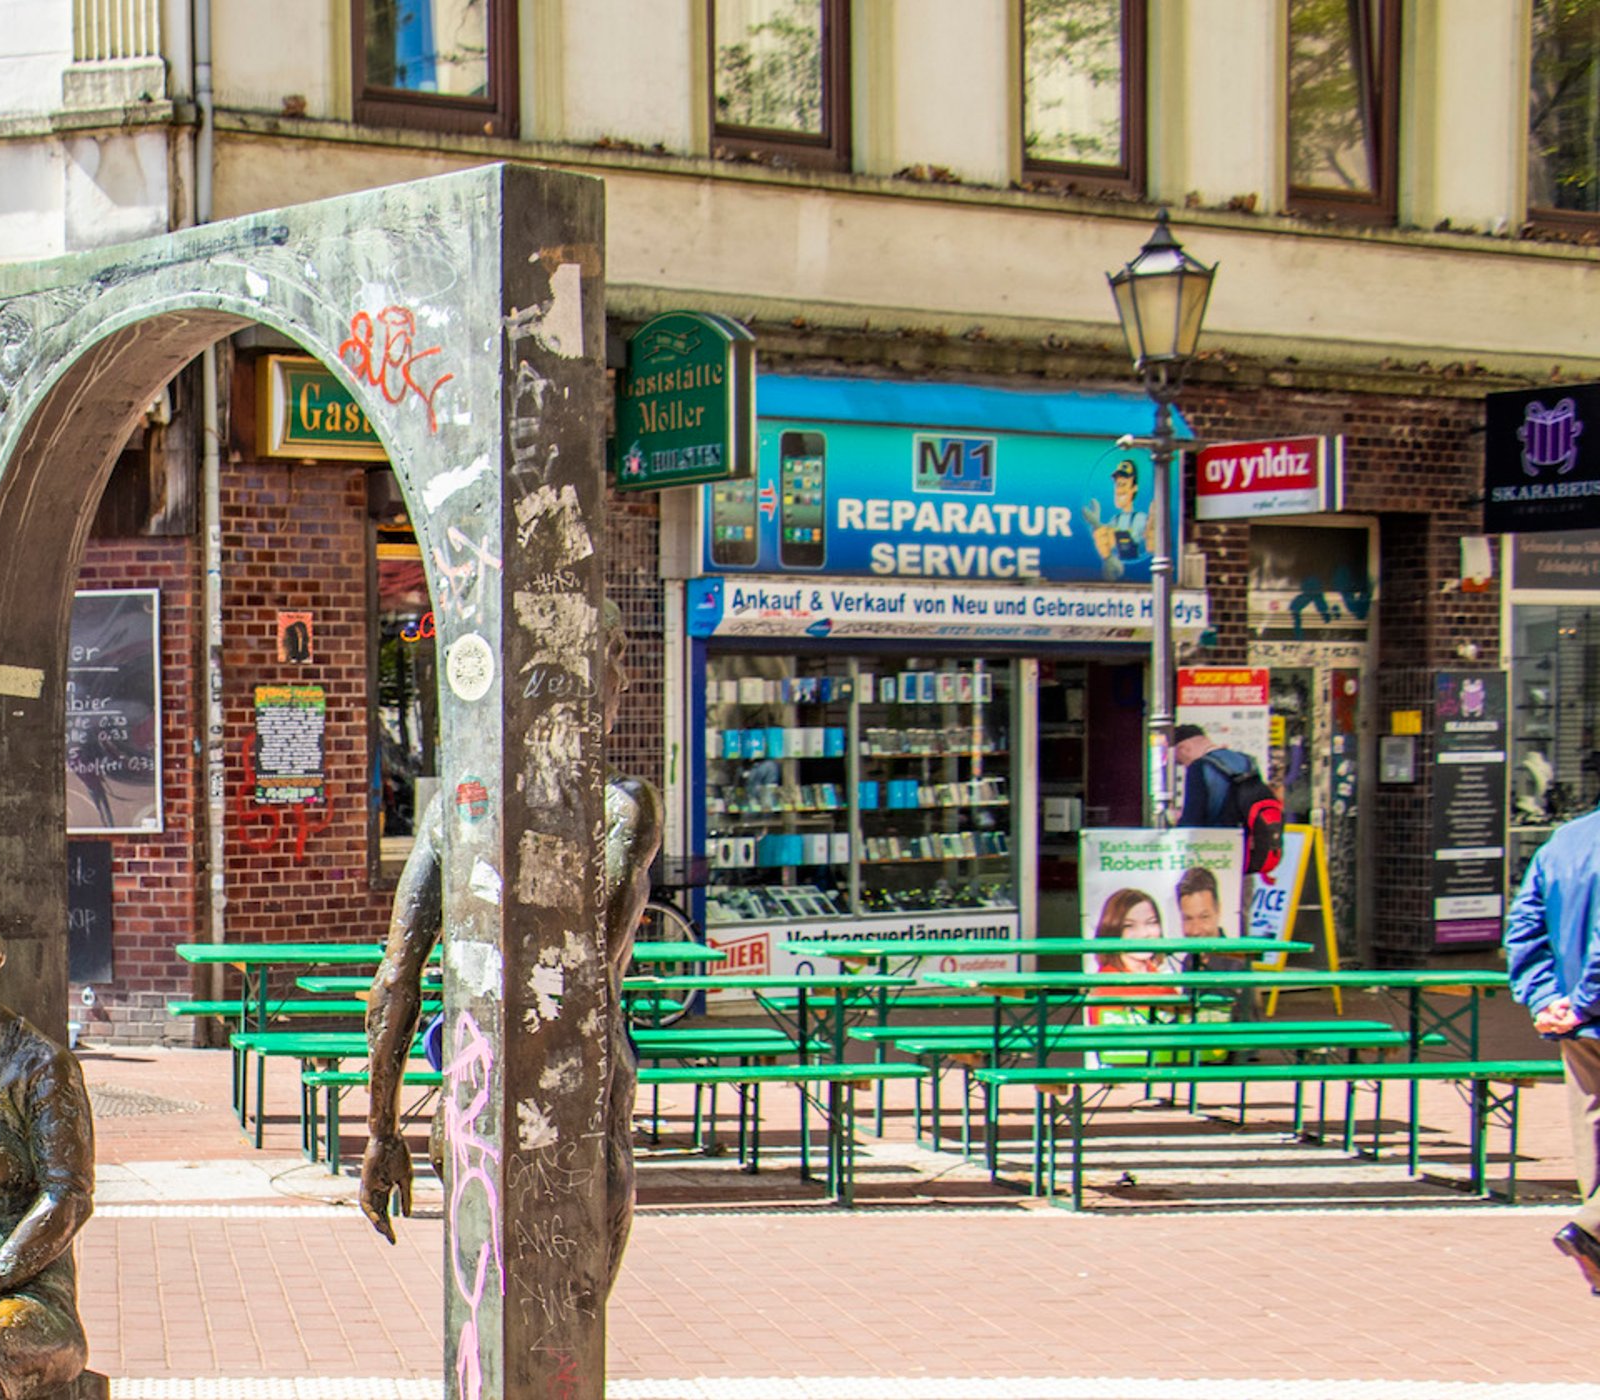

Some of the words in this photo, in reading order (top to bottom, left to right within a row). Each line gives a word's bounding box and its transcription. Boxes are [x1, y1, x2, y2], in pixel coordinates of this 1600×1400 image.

[621, 362, 722, 397] Gaststätte
[639, 400, 705, 434] Möller
[651, 443, 722, 473] HOLSTEN
[1205, 457, 1237, 490] ay
[1491, 480, 1600, 502] SKARABEUS
[837, 498, 1073, 538] REPARATUR
[870, 542, 1041, 578] SERVICE
[732, 588, 802, 612] Ankauf
[810, 590, 824, 612] &
[831, 590, 907, 613] Verkauf
[914, 599, 946, 614] von
[952, 594, 988, 615] Neu
[994, 596, 1027, 616] und
[1033, 596, 1135, 618] Gebrauchte
[1141, 599, 1203, 624] Hdys
[1100, 855, 1163, 871] Robert
[1169, 855, 1231, 871] Habeck
